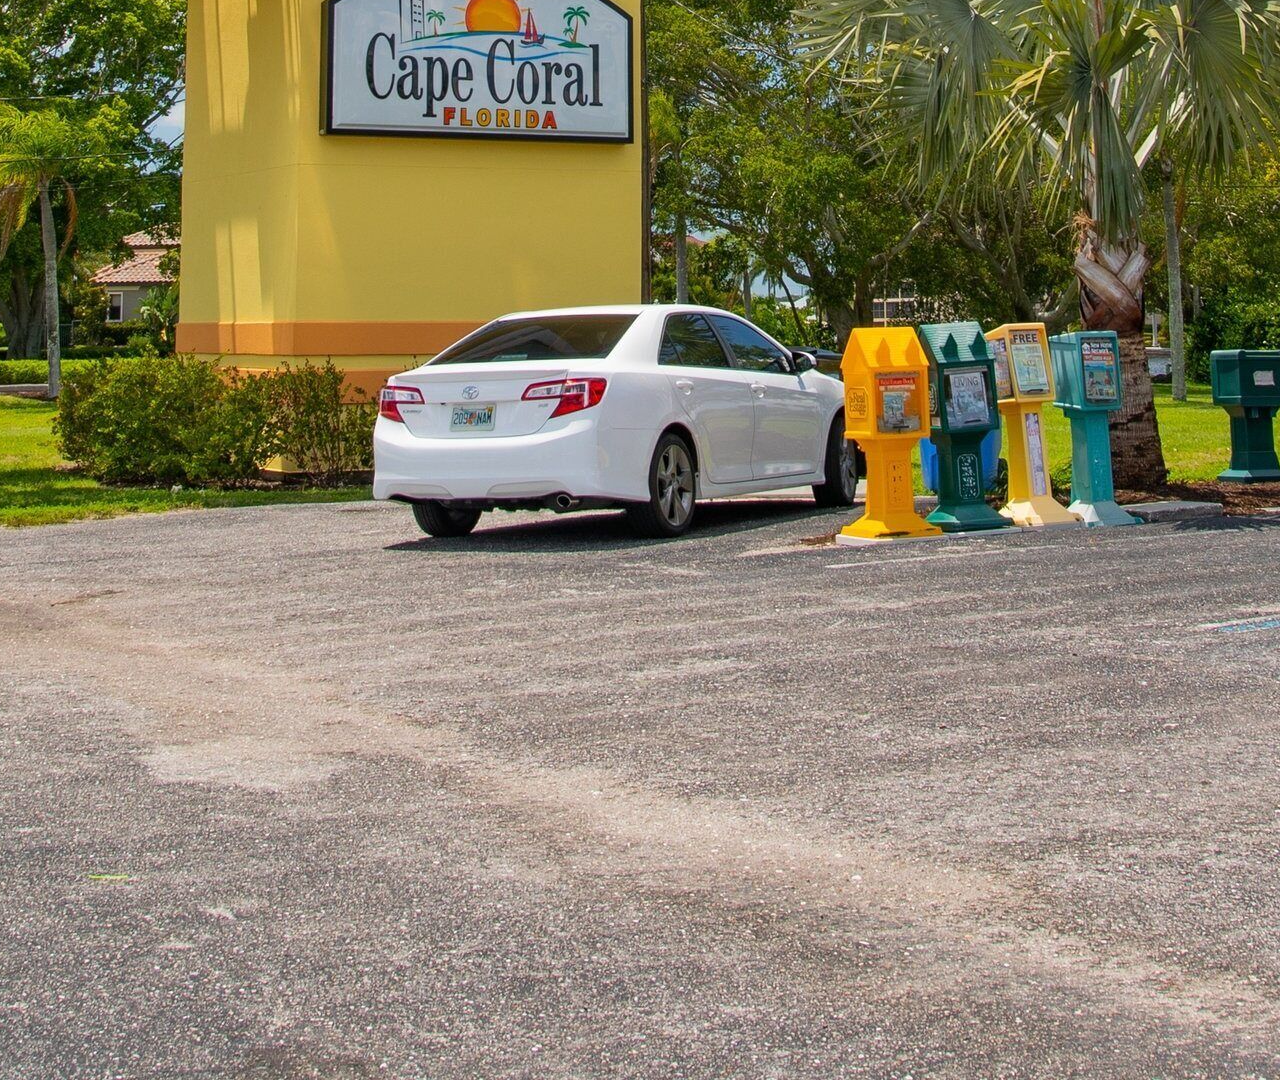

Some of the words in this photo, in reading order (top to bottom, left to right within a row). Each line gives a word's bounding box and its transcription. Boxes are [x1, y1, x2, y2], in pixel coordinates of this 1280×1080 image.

[366, 32, 474, 118] Cape
[486, 38, 604, 107] Coral
[443, 107, 558, 129] FLORIDA
[1012, 333, 1038, 344] FREE
